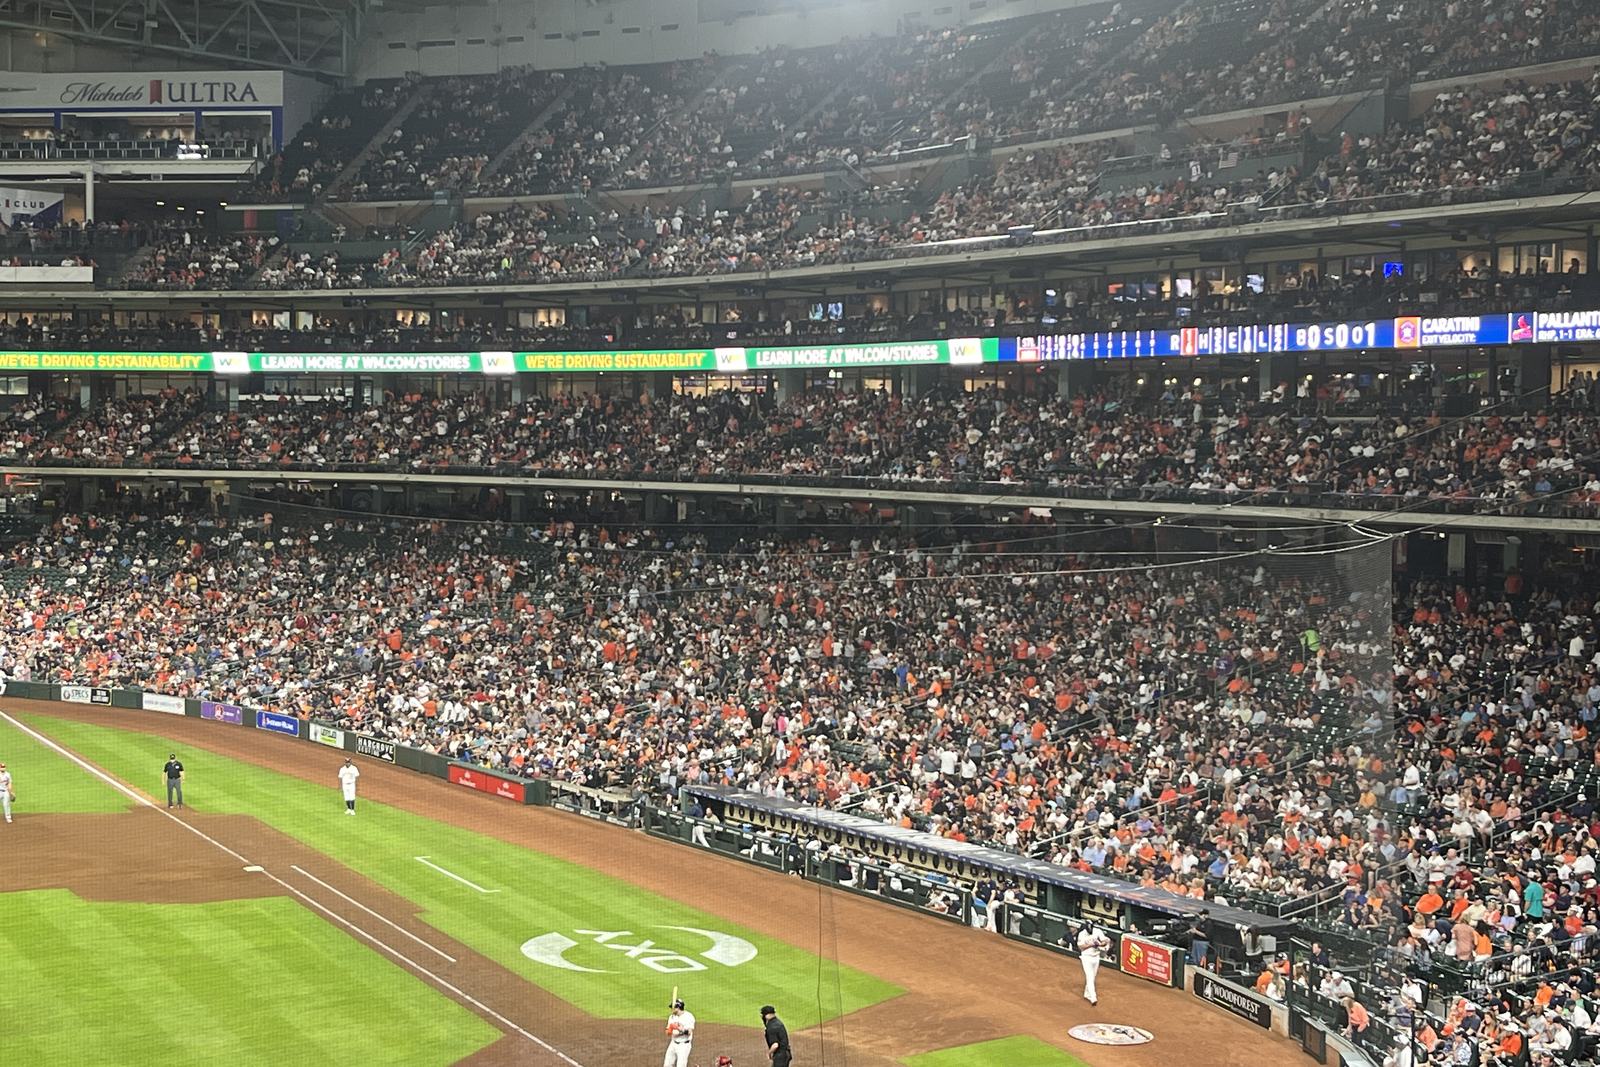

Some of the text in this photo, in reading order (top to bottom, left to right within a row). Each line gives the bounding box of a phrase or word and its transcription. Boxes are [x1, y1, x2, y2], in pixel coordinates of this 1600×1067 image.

[60, 81, 259, 104] Michelob ULTRA
[14, 200, 45, 208] CLUB
[1422, 316, 1480, 333] CARATINI
[1538, 311, 1600, 328] PALLANT
[1170, 334, 1179, 351] R
[1199, 333, 1208, 349] H
[1228, 331, 1237, 349] E
[1258, 331, 1267, 348] L
[42, 354, 96, 368] DRIVING
[261, 355, 470, 369] LEARN MORE AT WM.COM/STORIES
[526, 355, 563, 368] WE'RE
[566, 355, 611, 368] DRIVING
[756, 345, 939, 366] LEARN MORE AT WM.COM/STORIES
[357, 737, 394, 754] HARGROVE
[1213, 983, 1260, 1014] WOODFOREST
